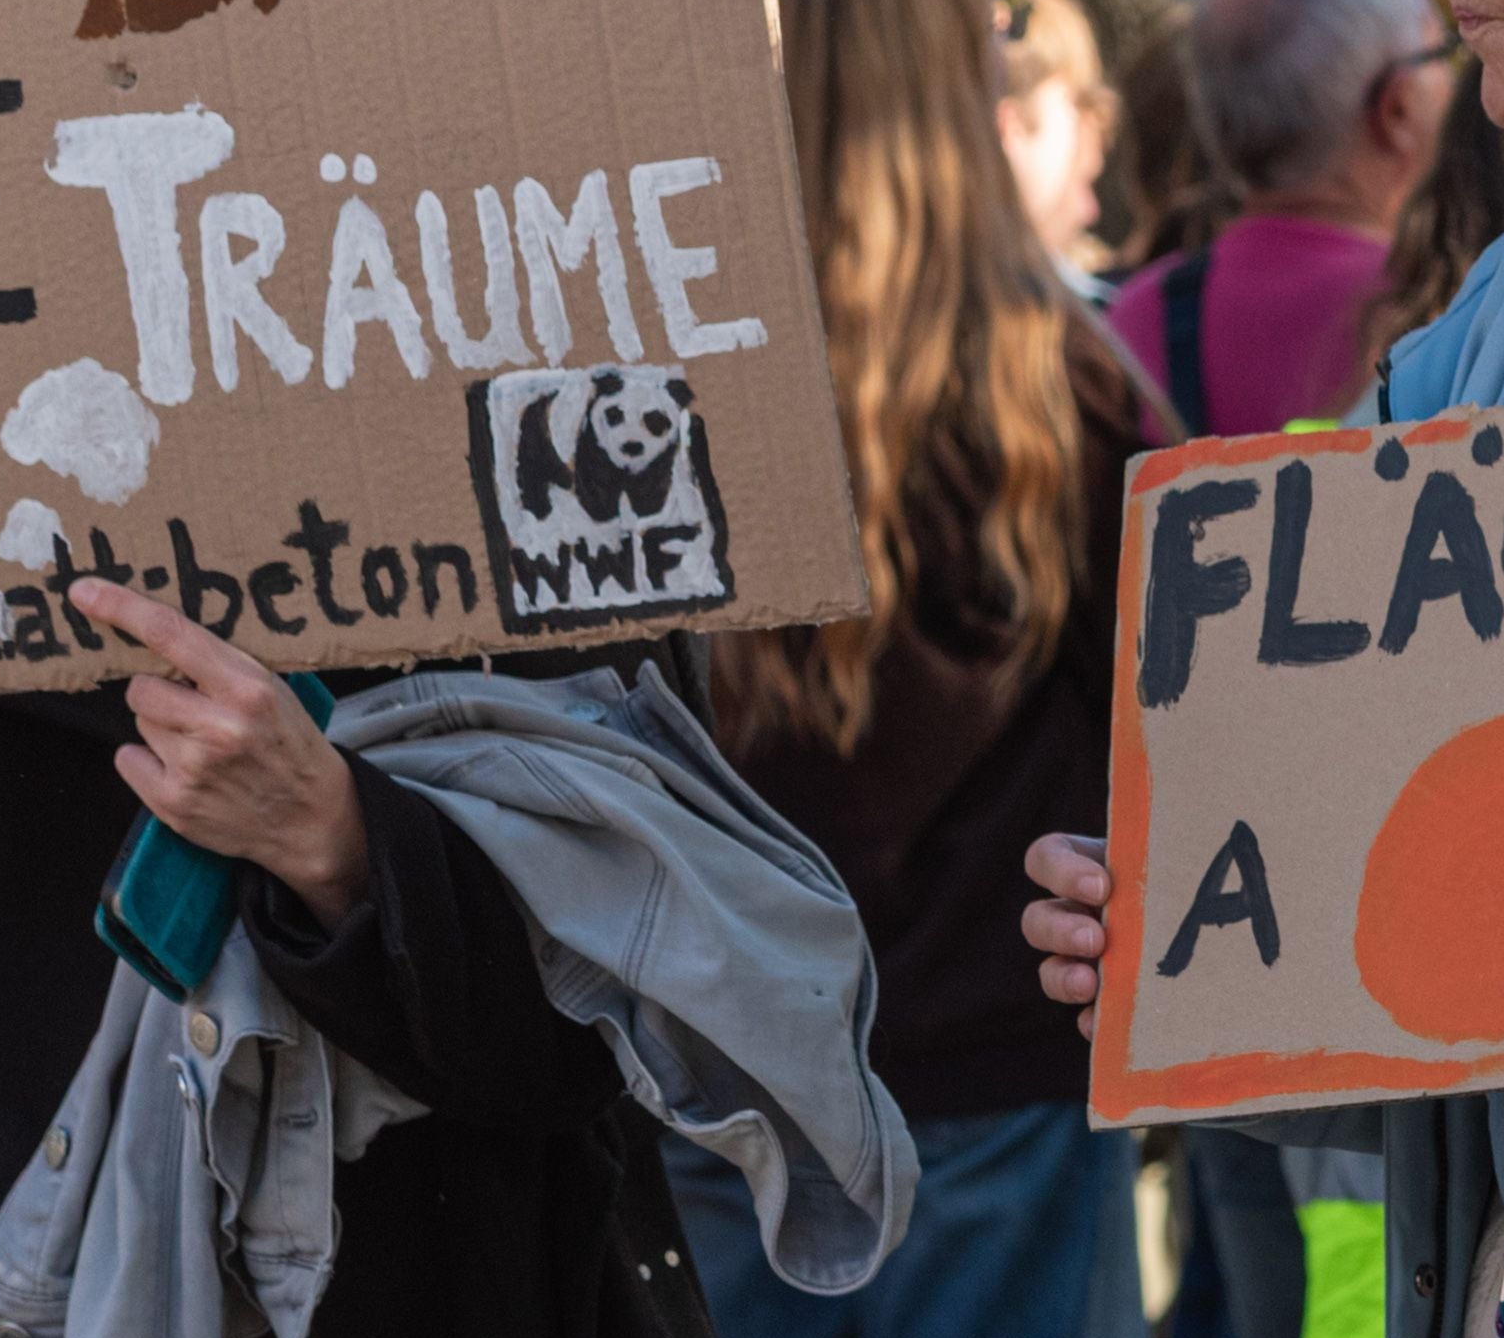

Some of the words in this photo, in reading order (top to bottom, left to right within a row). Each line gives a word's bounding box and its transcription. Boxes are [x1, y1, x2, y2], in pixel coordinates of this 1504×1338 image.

[45, 104, 768, 405] TRÄUME
[511, 525, 701, 607] WWF
[1157, 820, 1282, 979] A
